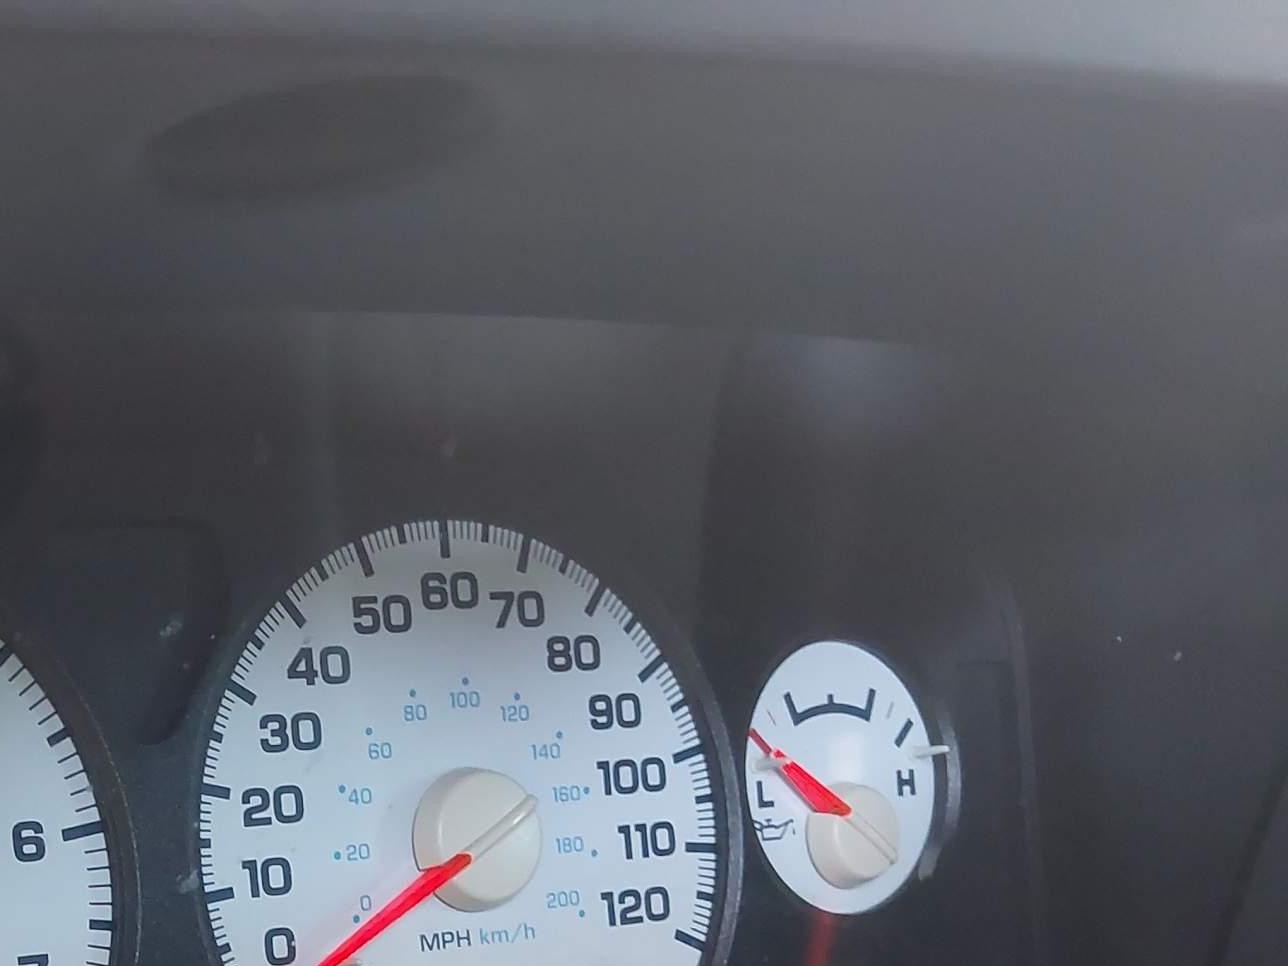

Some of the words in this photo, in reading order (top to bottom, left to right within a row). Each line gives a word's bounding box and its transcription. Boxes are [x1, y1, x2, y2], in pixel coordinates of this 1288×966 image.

[421, 572, 479, 609] 60
[352, 596, 412, 634] 50
[489, 591, 545, 628] 70
[287, 647, 351, 685] 40
[546, 636, 600, 671] 80
[404, 705, 427, 721] 80
[449, 692, 480, 707] 100
[500, 705, 530, 722] 120
[588, 693, 641, 730] 90
[259, 713, 322, 753] 30
[368, 743, 392, 759] 60
[531, 743, 560, 759] 140
[597, 757, 667, 795] 100
[896, 769, 916, 796] H
[241, 785, 304, 827] 20
[348, 788, 373, 804] 40
[552, 785, 581, 802] 160
[756, 781, 774, 808] L
[12, 821, 46, 862] 6
[346, 844, 371, 860] 20
[555, 837, 584, 854] 180
[618, 822, 675, 860] 110
[242, 857, 292, 898] 10
[360, 895, 372, 912] 0
[547, 890, 580, 909] 200
[601, 886, 670, 927] 120
[264, 927, 297, 965] 0
[420, 929, 472, 952] MPH
[479, 921, 536, 945] km/h
